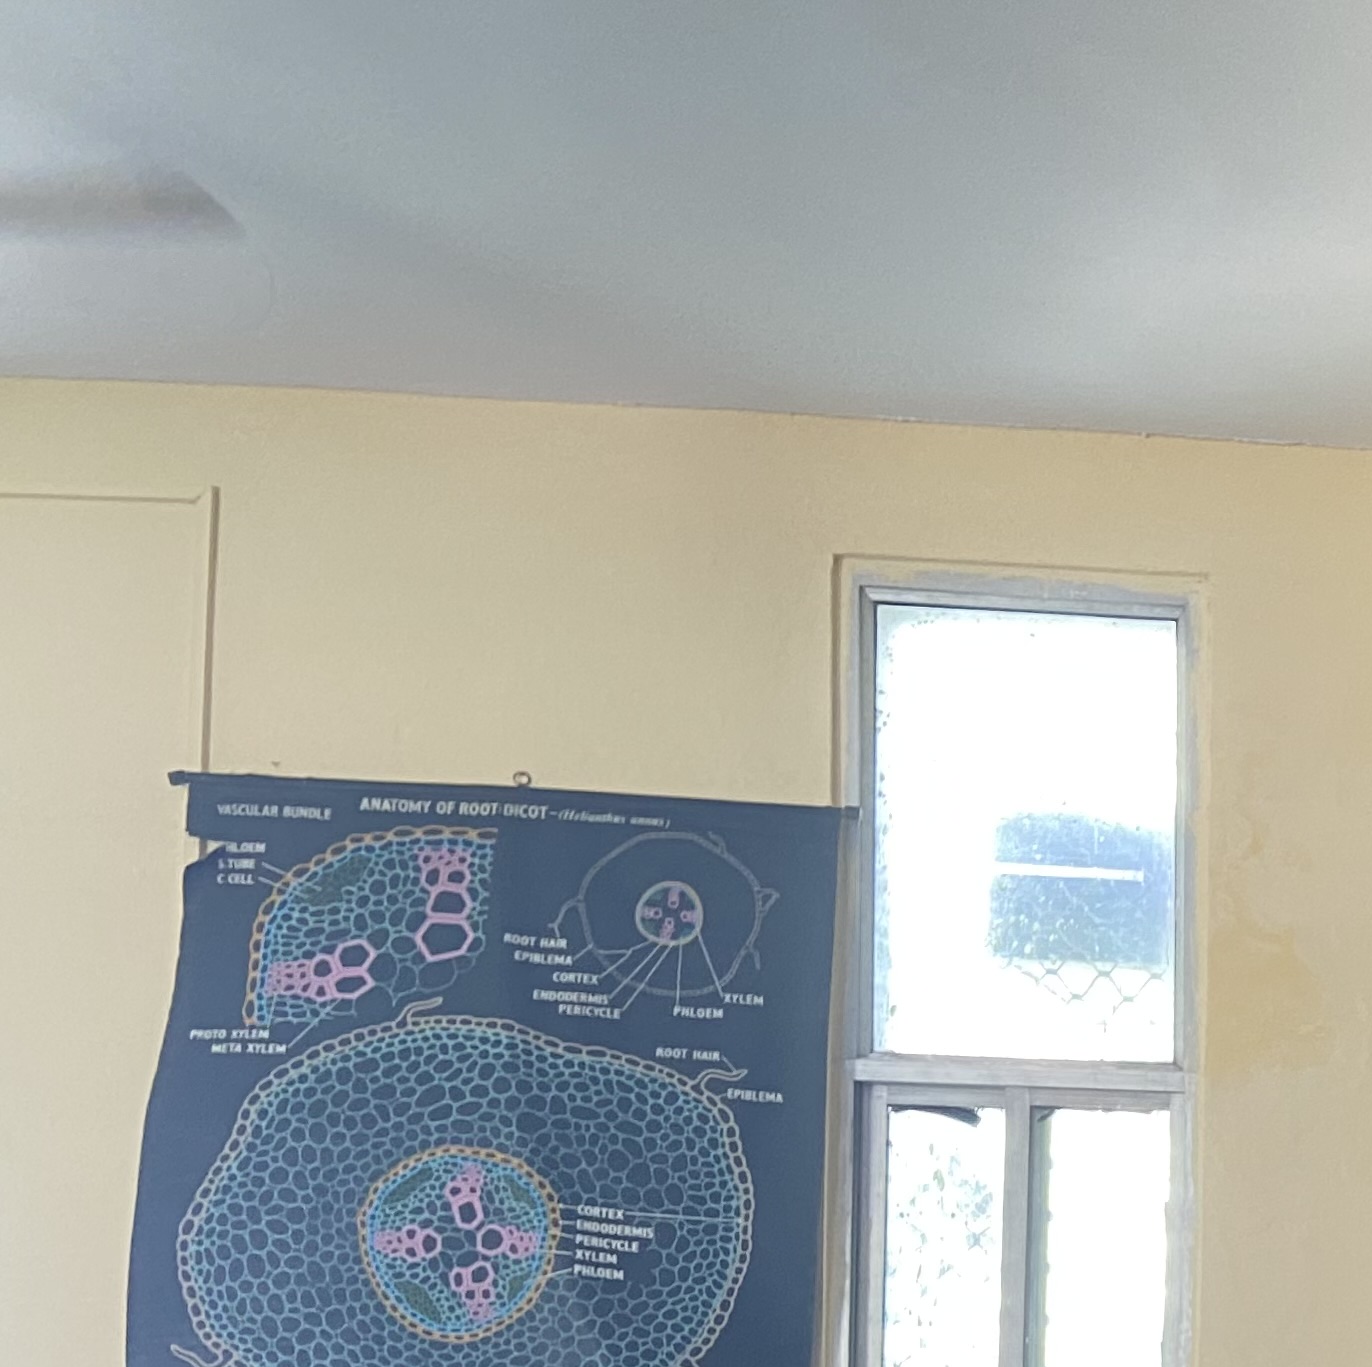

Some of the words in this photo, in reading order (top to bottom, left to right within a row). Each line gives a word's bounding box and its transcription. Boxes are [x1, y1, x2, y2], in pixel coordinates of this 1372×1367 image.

[217, 804, 278, 817] VASCULAR
[283, 806, 332, 820] BUNDLE
[360, 797, 431, 814] ANATOMY
[436, 799, 456, 815] OF
[458, 801, 498, 816] ROOT
[227, 859, 256, 869] TUBE
[217, 873, 225, 884] C
[227, 873, 255, 885] CELL
[504, 933, 536, 947] ROOT
[540, 936, 567, 949] HAIR
[514, 951, 573, 966] EPIBLEMA
[553, 972, 599, 986] CORTEX
[533, 989, 609, 1004] ENDODERMIS
[724, 994, 763, 1006] XYLEM
[558, 1004, 621, 1019] PERICYCLE
[673, 1006, 723, 1018] PHLOEM
[190, 1029, 226, 1040] PROTO
[231, 1029, 270, 1039] XYLEM
[211, 1042, 242, 1053] META
[246, 1043, 287, 1054] XYLEM
[656, 1047, 688, 1059] ROOT
[692, 1050, 720, 1061] HAIR
[727, 1088, 783, 1103] EPIBLEMA
[577, 1205, 624, 1220] CORTEX
[576, 1219, 654, 1239] ENDODERMIS
[575, 1234, 639, 1253] PERICYCLE
[575, 1249, 618, 1265] XYLEM
[573, 1264, 624, 1280] PHLOEM
